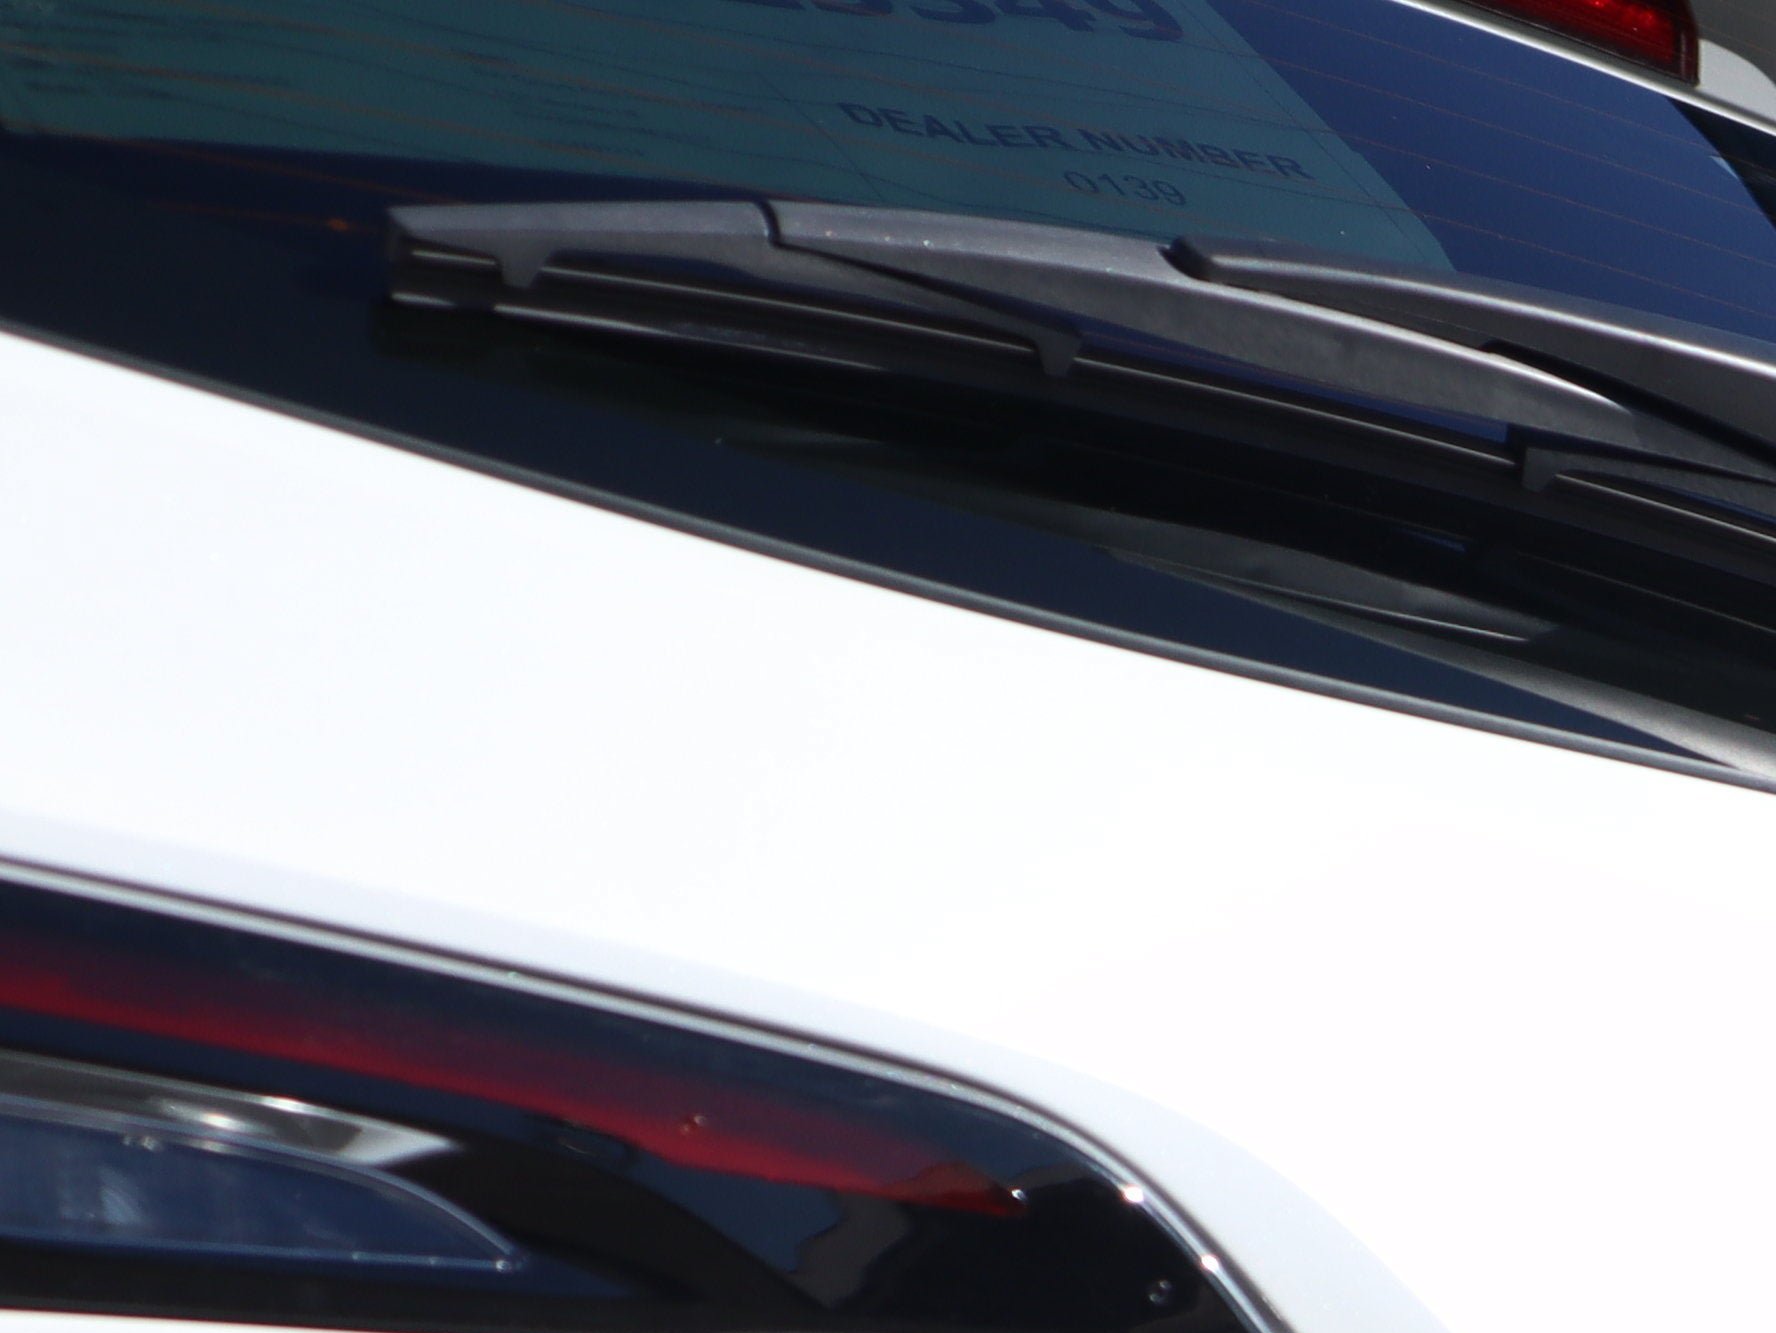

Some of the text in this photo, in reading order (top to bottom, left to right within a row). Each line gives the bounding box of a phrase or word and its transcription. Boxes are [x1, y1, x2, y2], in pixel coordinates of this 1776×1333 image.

[837, 101, 1315, 180] DEALER NUMBER
[1062, 170, 1187, 206] 0139
